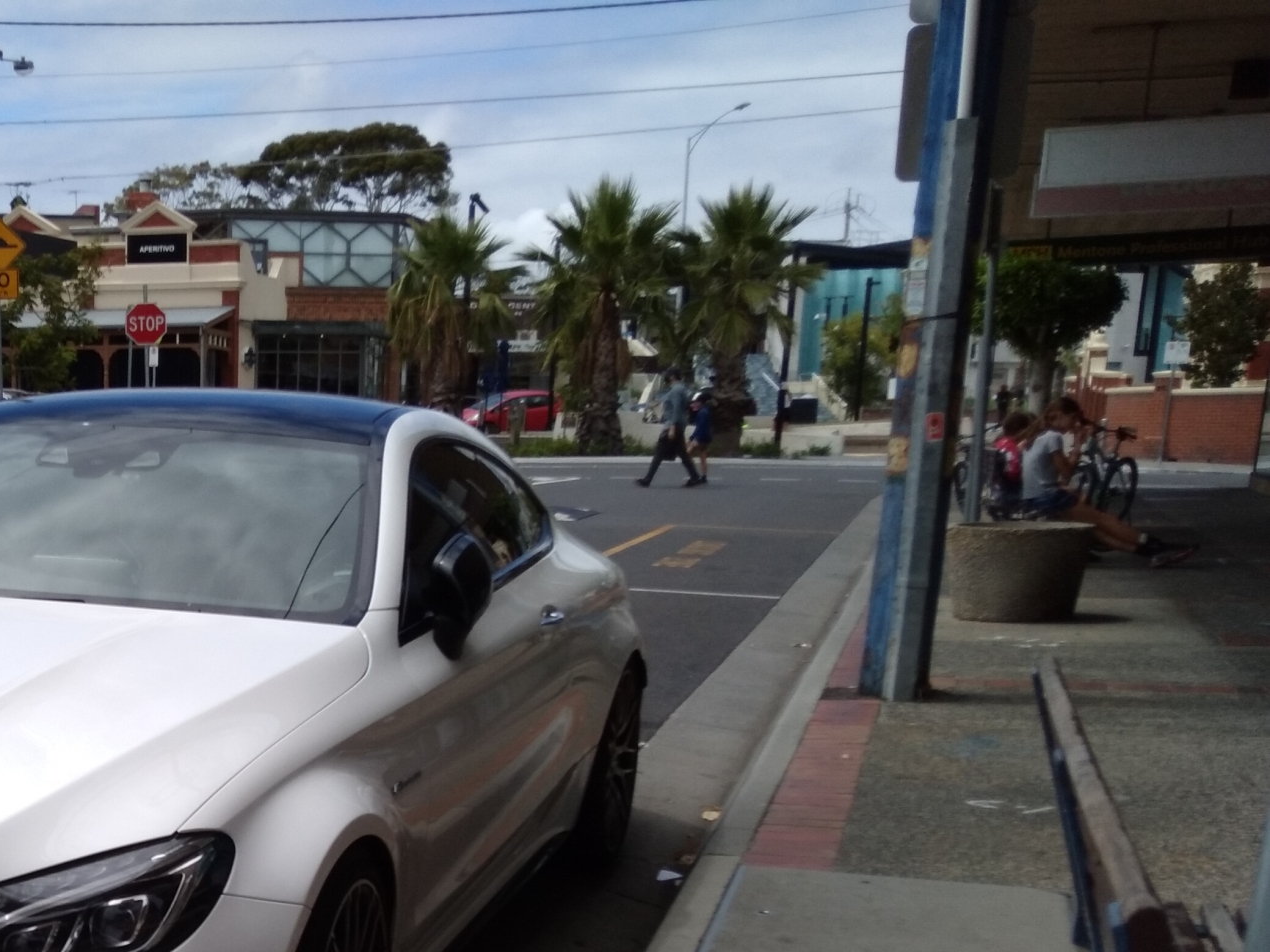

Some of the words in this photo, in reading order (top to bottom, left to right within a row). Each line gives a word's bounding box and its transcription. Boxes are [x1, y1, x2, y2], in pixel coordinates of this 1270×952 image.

[139, 244, 176, 254] APERITIVO
[1056, 244, 1126, 259] Mentone
[1130, 236, 1227, 256] Professional
[129, 314, 164, 333] STOP
